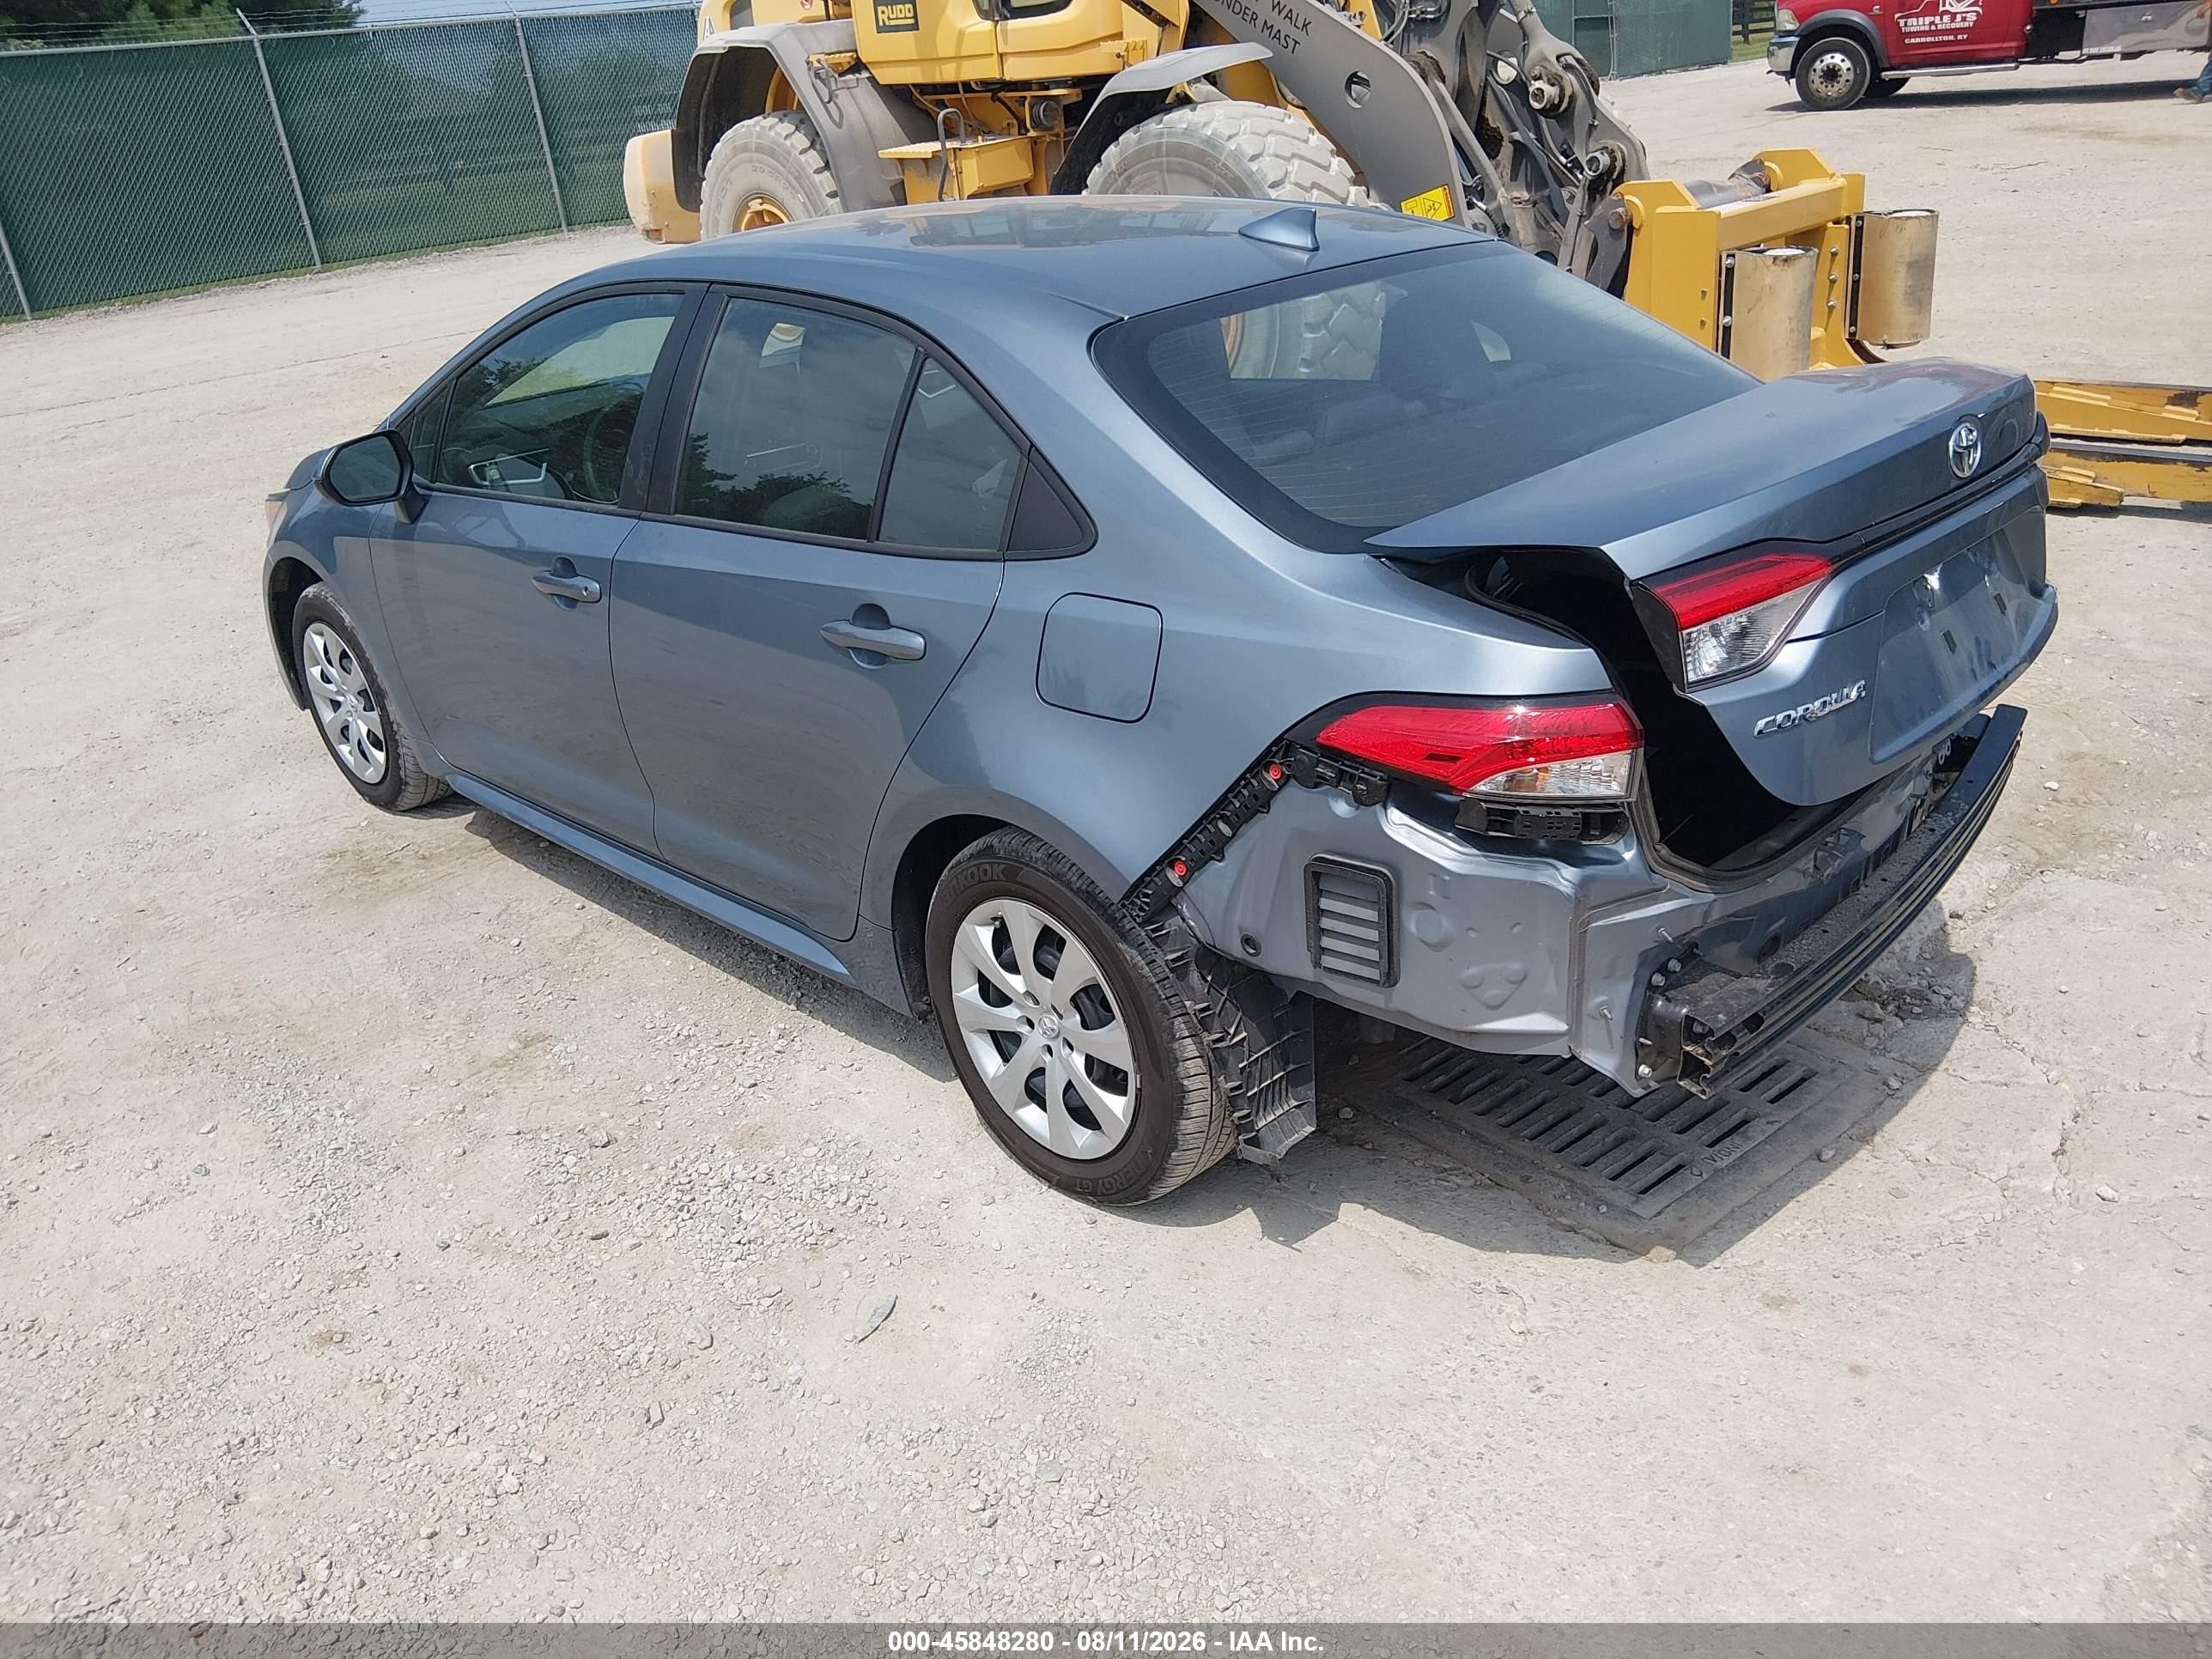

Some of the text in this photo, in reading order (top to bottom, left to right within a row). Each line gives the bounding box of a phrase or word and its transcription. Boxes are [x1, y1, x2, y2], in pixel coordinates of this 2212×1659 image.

[877, 4, 915, 26] RUDD
[1214, 0, 1301, 54] NDER MAST
[1271, 0, 1312, 36] WALK
[1897, 12, 1978, 27] TRIPLE J'S
[1753, 679, 1866, 737] COROLLA
